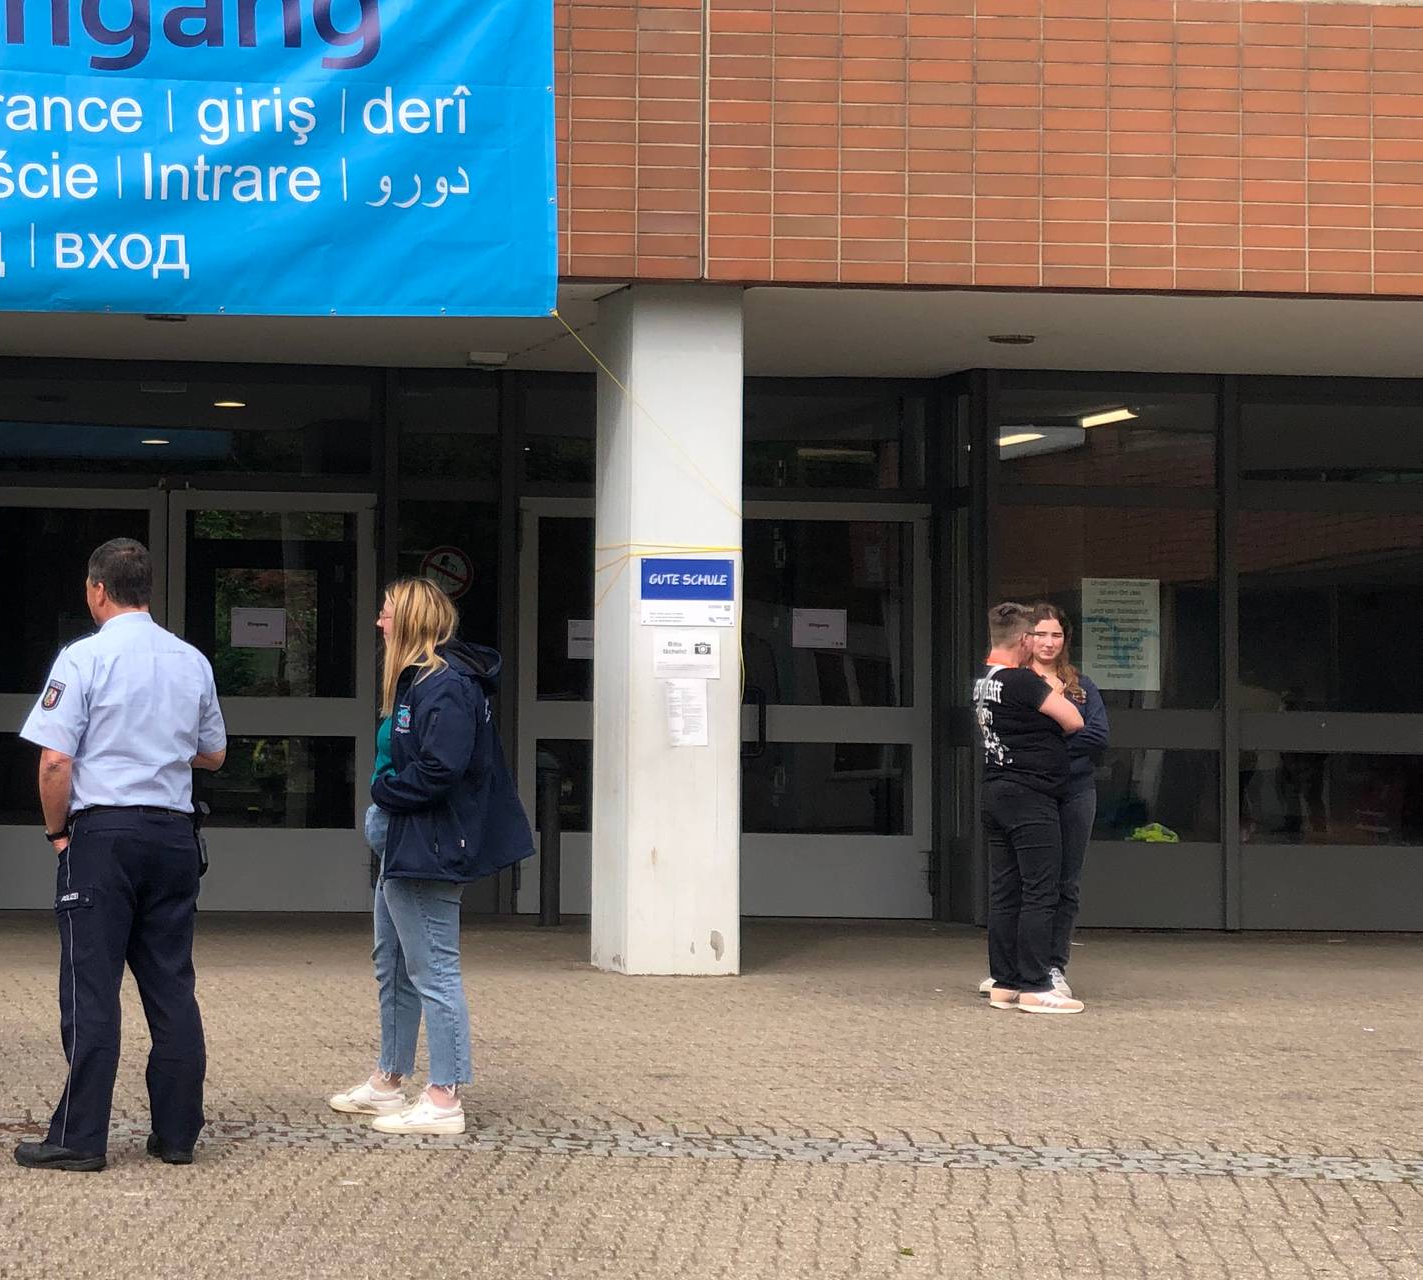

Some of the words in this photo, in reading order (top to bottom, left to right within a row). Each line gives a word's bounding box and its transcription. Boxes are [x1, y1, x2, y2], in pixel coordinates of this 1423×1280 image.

[198, 87, 315, 145] giriş
[364, 86, 472, 134] derî
[144, 153, 320, 202] Intrare
[56, 233, 189, 278] вход
[649, 574, 680, 584] GUTE
[683, 574, 727, 585] SCHULE
